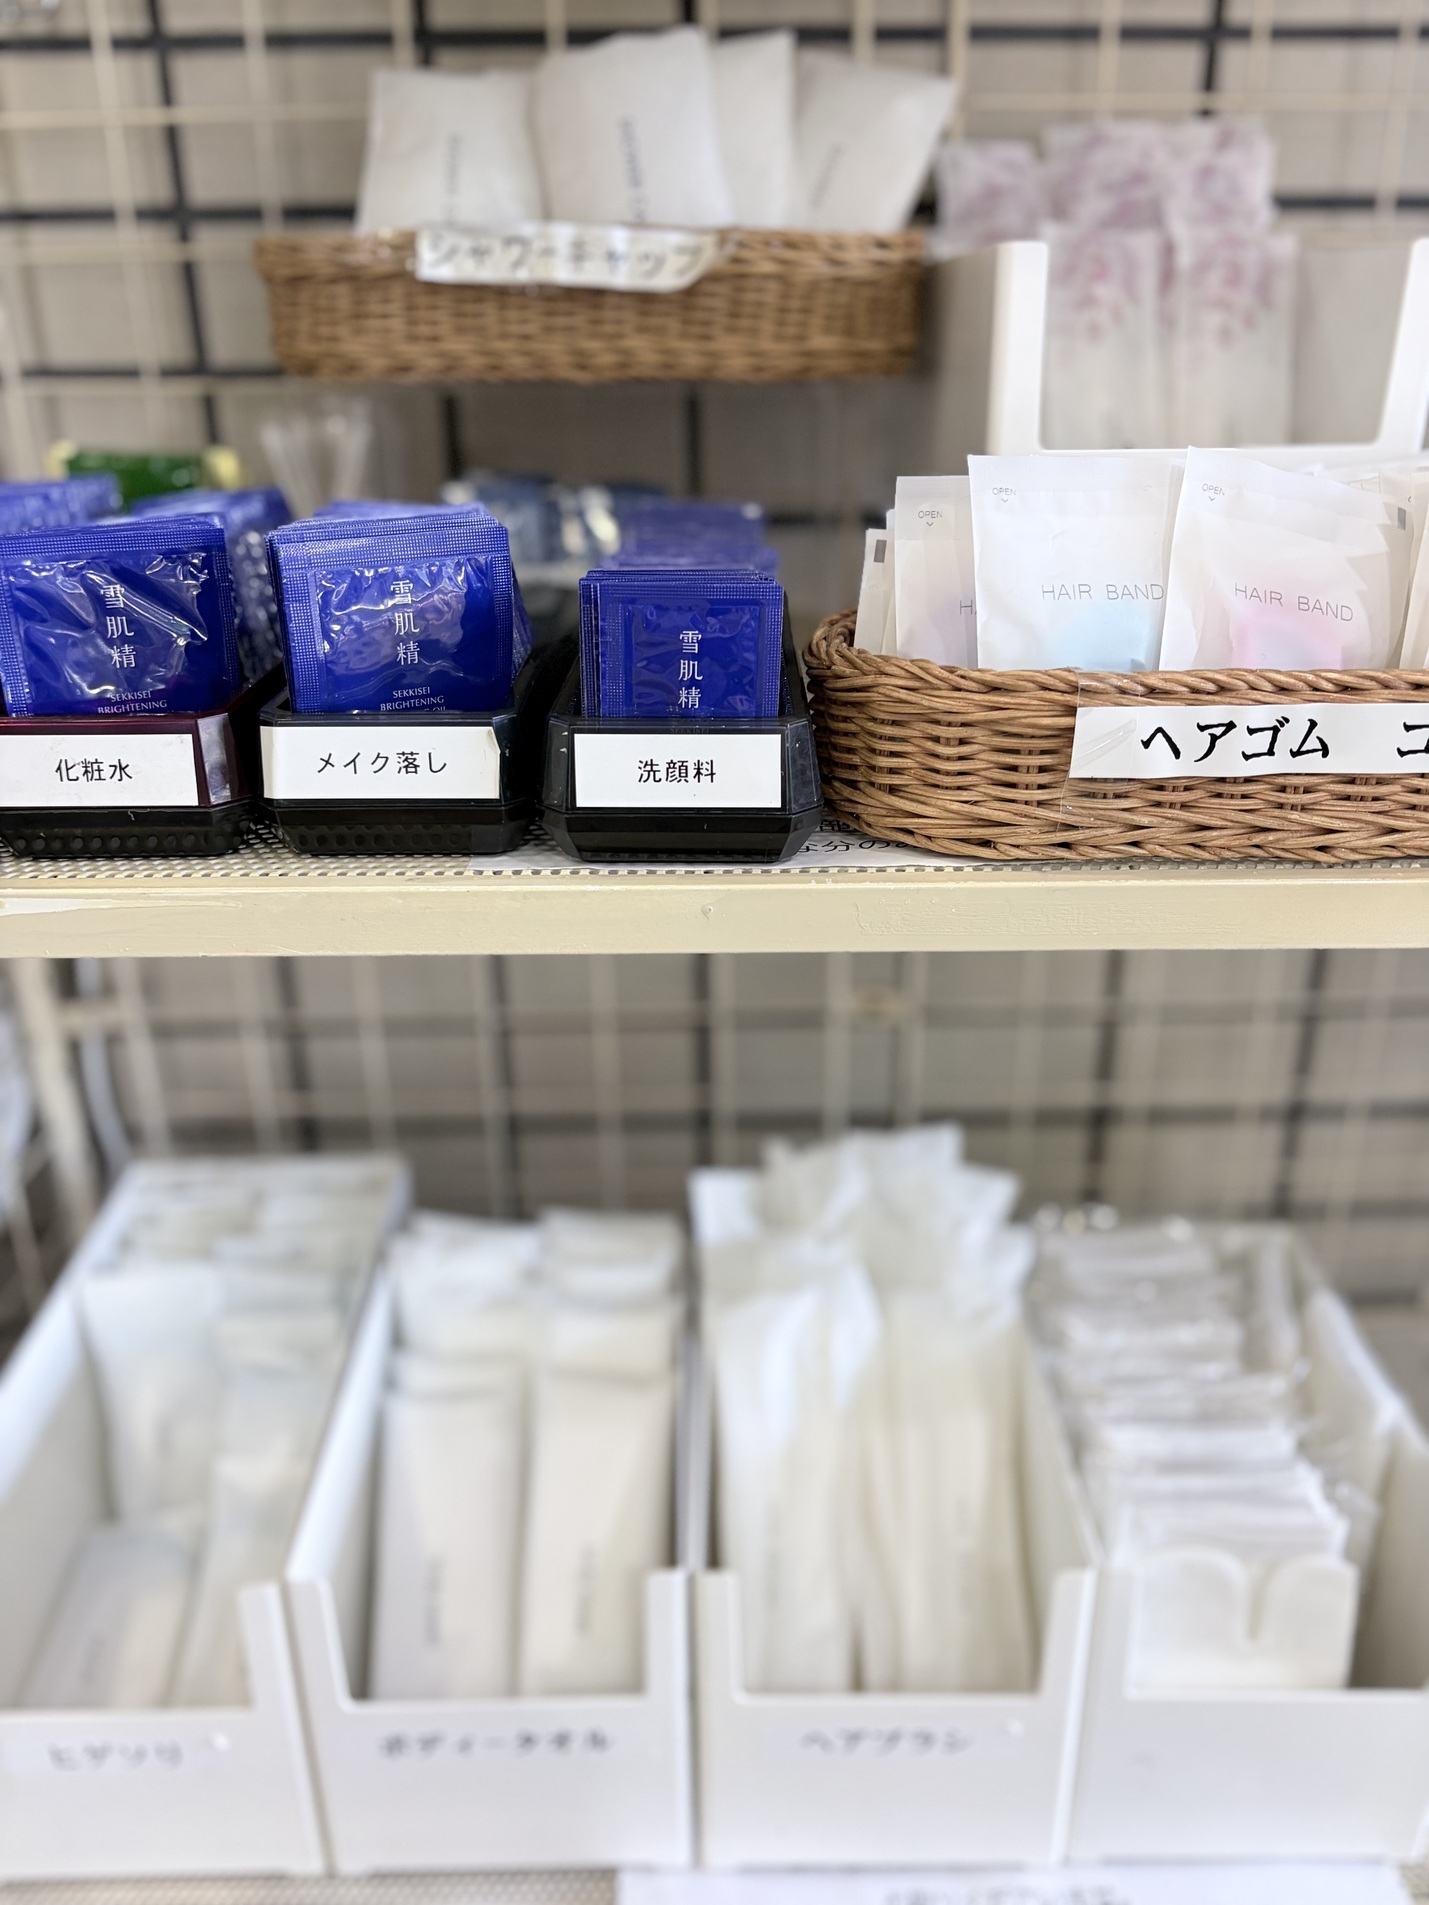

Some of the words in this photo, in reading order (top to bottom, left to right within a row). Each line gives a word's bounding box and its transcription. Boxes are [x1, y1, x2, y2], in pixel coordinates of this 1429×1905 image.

[991, 487, 1017, 496] OPEN
[1201, 483, 1226, 497] OPEN
[917, 510, 943, 519] OPEN
[1041, 583, 1093, 601] HAIR
[1105, 583, 1165, 601] BAND
[959, 599, 978, 616] H
[1234, 582, 1284, 608] HAIR
[1297, 595, 1354, 622] BAND
[100, 583, 137, 670] 雪肌精
[390, 579, 421, 666] 雪肌精
[677, 630, 704, 710] 雪肌精
[110, 690, 152, 703] SEKKISEI
[392, 686, 431, 699] SEKKISEI
[97, 699, 168, 714] BRIGHTENING
[380, 695, 445, 712] BRIGHTENING
[1140, 715, 1330, 763] ヘアゴム
[54, 757, 133, 783] 化粧水
[316, 751, 448, 775] メイク落し
[636, 758, 717, 784] 洗顔料
